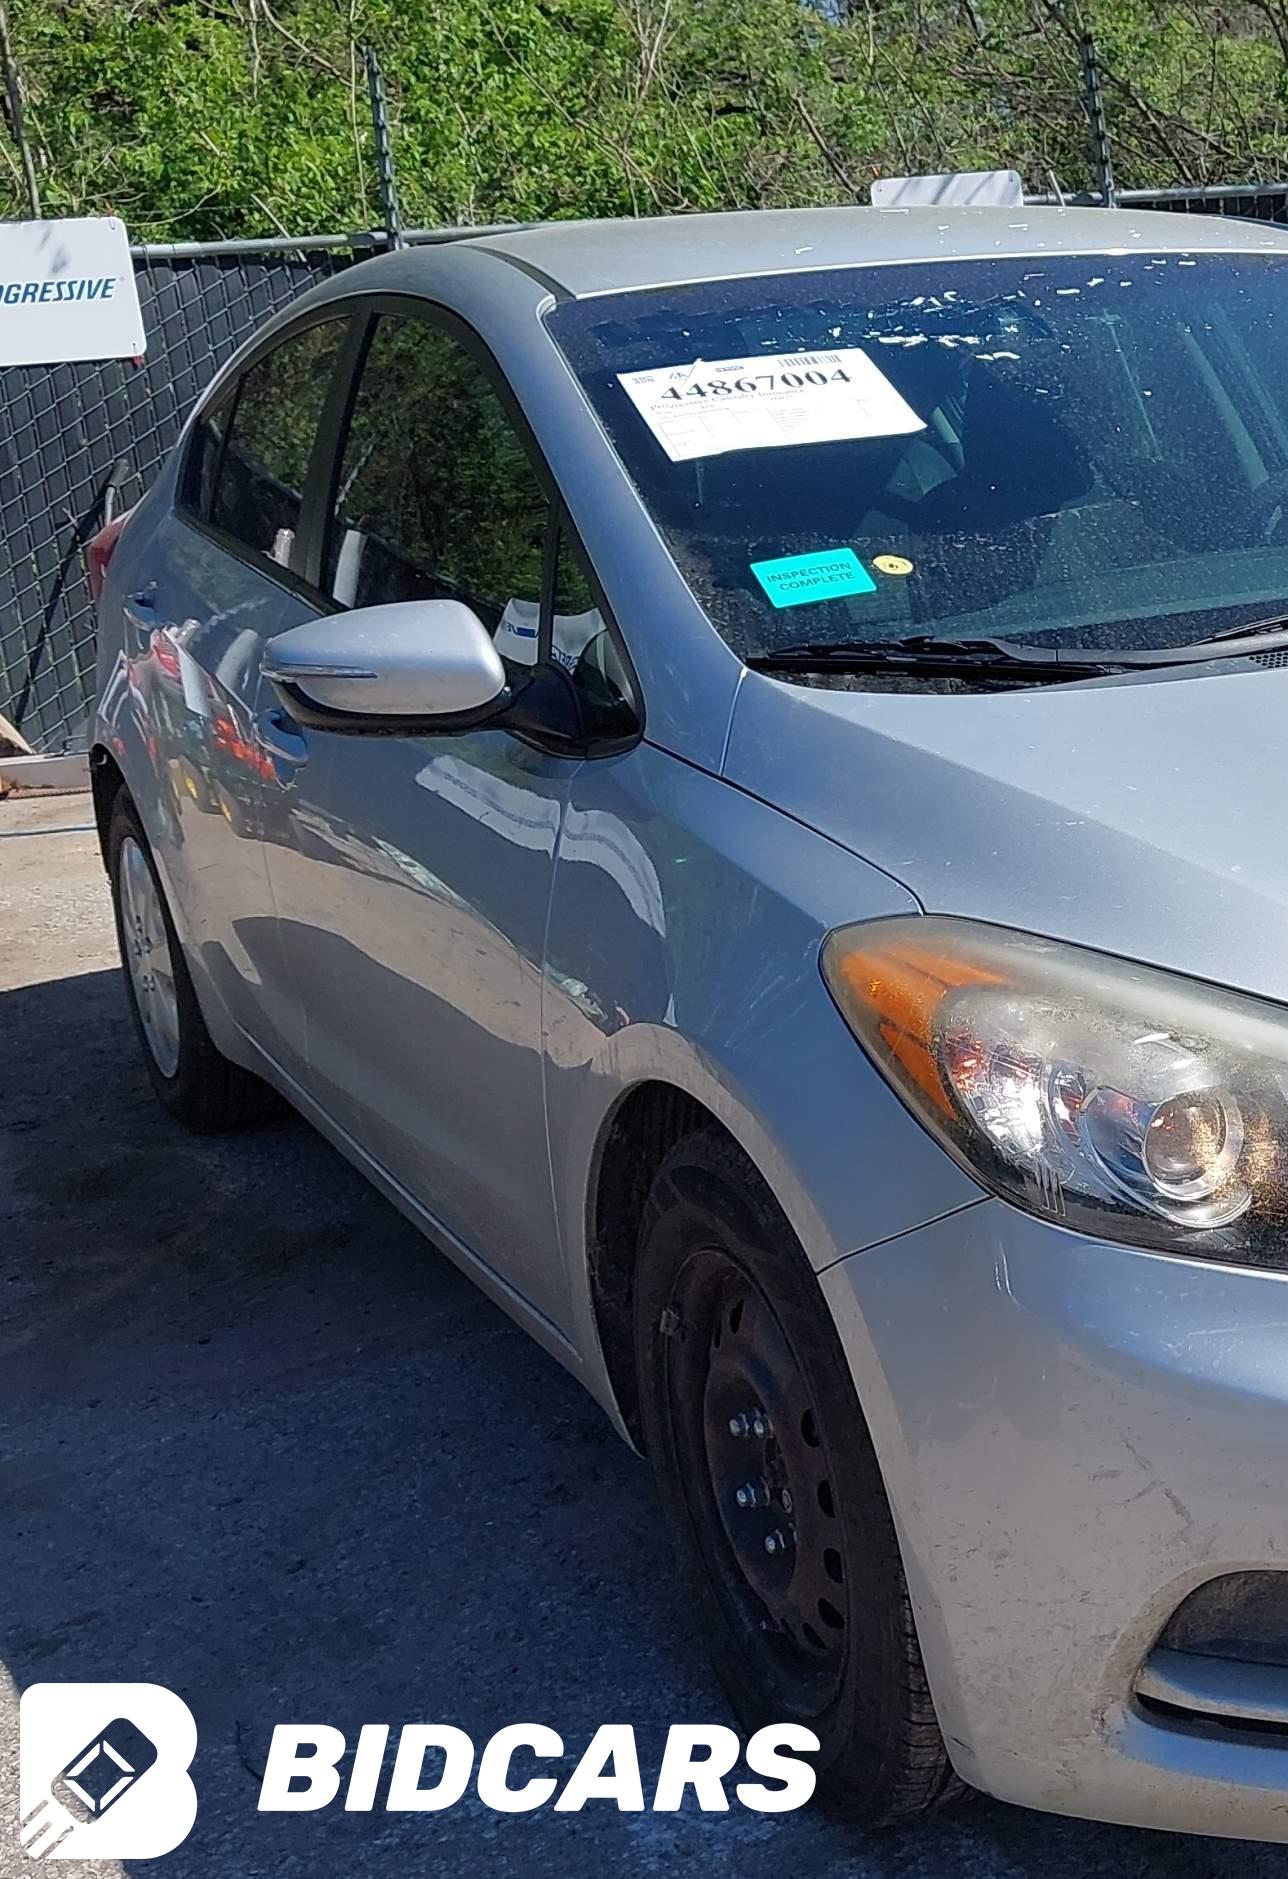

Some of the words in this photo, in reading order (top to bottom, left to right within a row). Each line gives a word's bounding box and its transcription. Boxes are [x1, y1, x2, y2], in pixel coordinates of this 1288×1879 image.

[661, 368, 851, 400] 44867004
[767, 562, 852, 583] INSPECTION
[779, 572, 855, 591] COMPLETE
